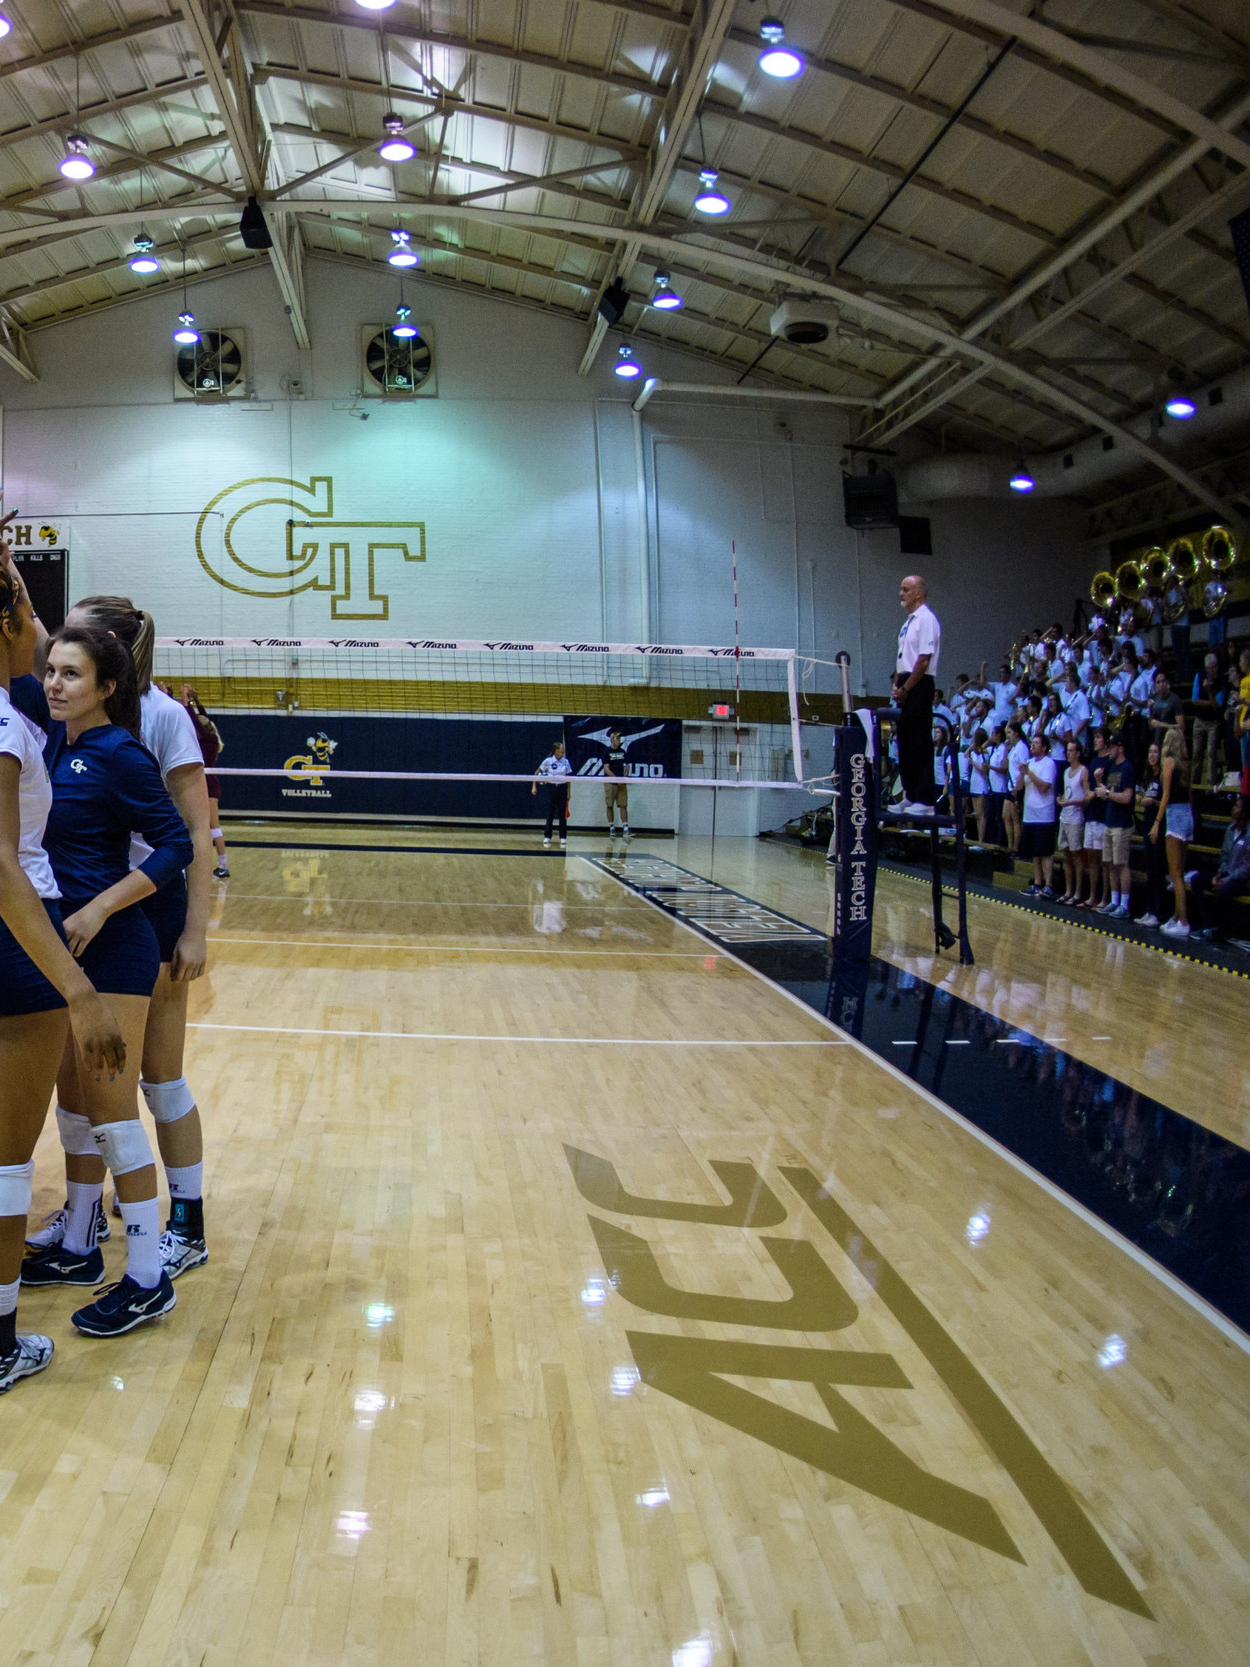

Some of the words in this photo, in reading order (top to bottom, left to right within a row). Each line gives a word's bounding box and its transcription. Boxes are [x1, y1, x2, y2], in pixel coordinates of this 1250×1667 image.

[195, 475, 426, 620] GT
[70, 759, 88, 774] GT
[281, 788, 332, 798] VOLLEYBALL
[284, 755, 331, 786] GT
[850, 754, 867, 855] GEORGIA
[850, 861, 867, 921] TECH
[561, 1142, 1028, 1567] ACC
